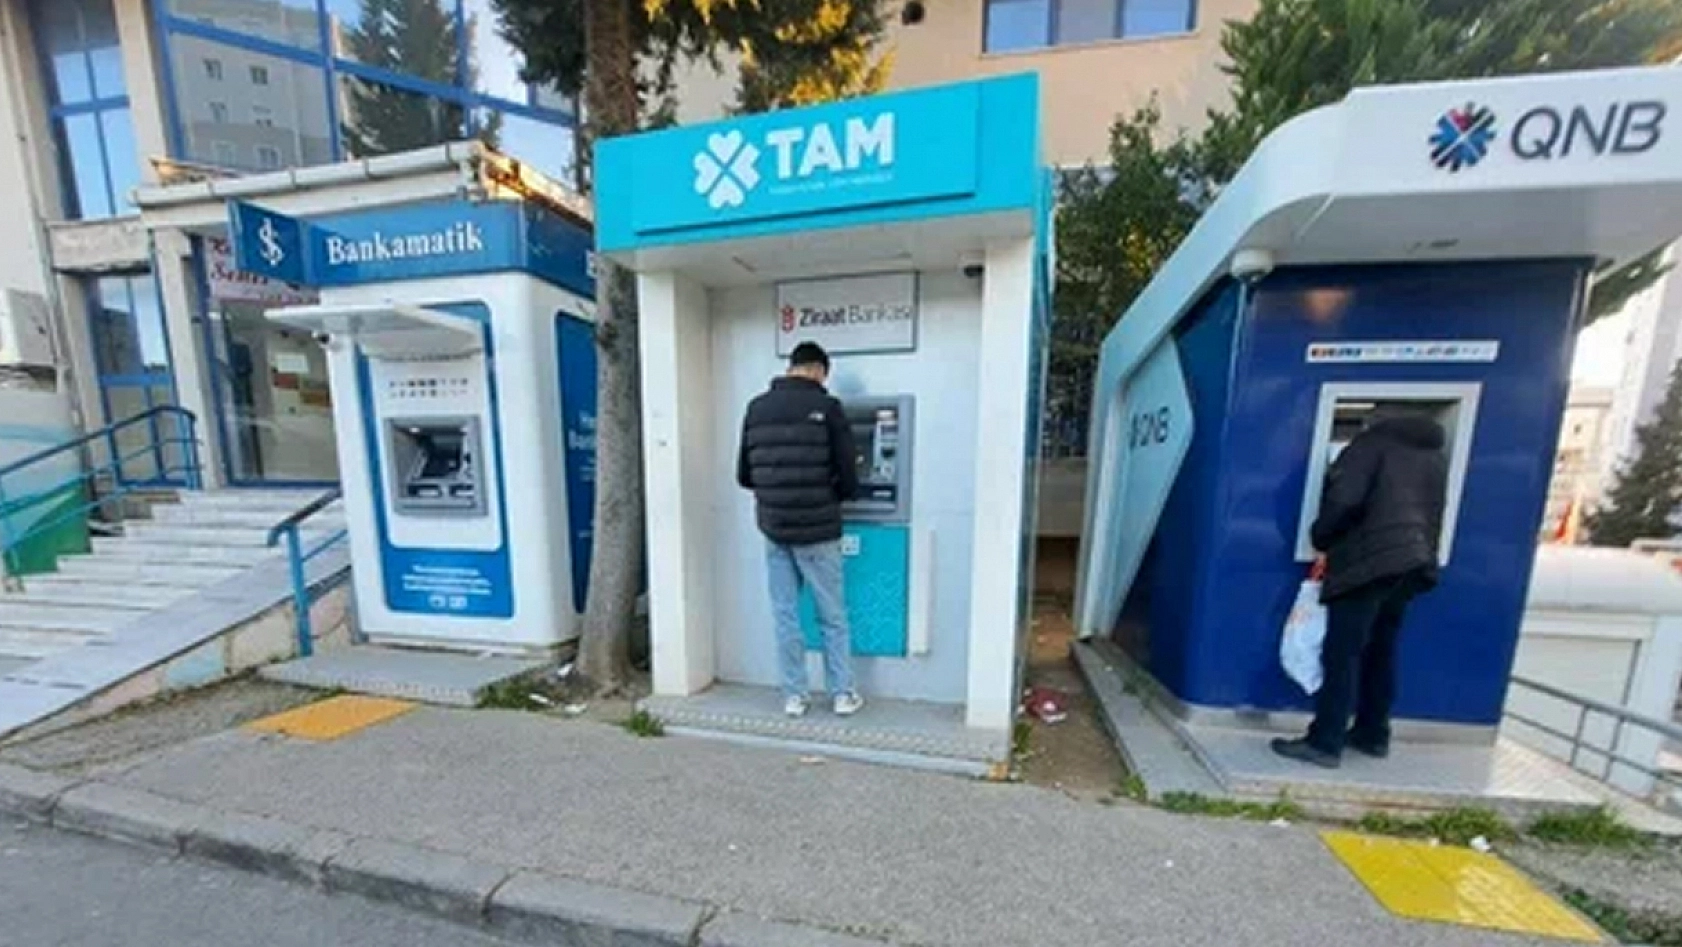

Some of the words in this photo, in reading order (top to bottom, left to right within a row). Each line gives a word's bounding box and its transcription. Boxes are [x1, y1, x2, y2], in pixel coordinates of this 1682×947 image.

[766, 111, 895, 178] TAM
[1510, 101, 1667, 160] QNB
[326, 220, 483, 265] Bankamatik
[800, 307, 845, 327] Ziraat
